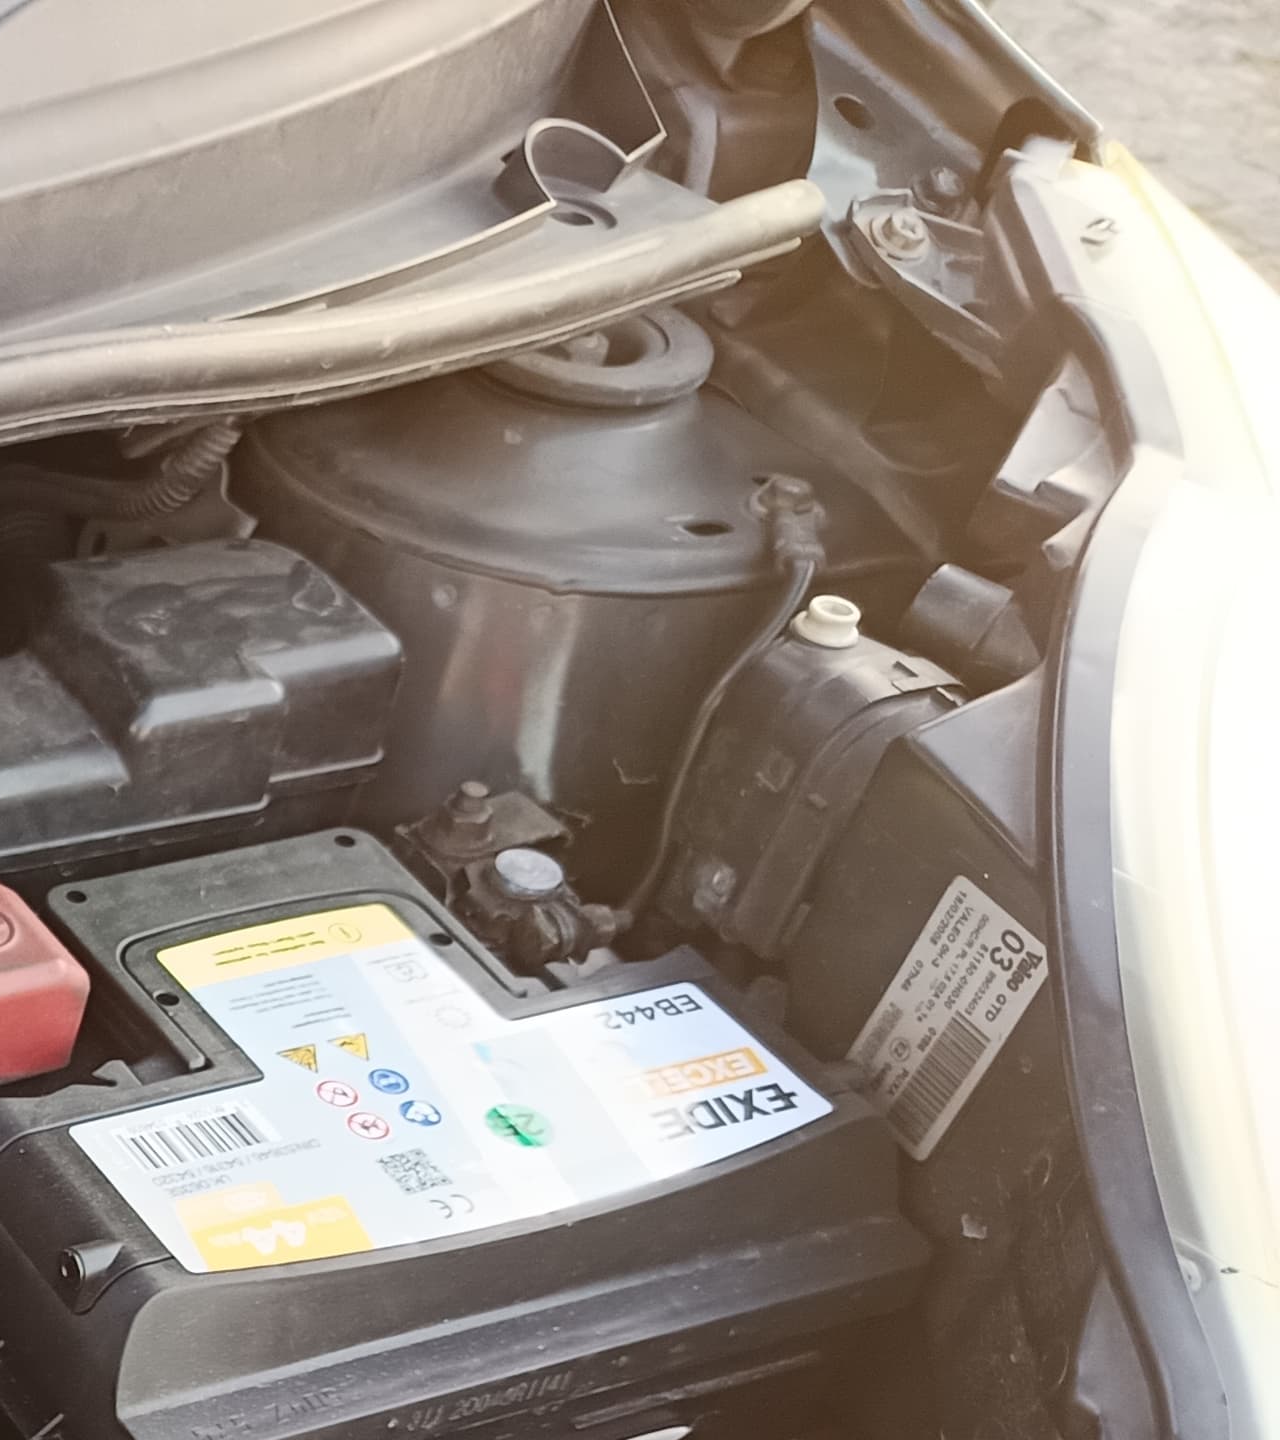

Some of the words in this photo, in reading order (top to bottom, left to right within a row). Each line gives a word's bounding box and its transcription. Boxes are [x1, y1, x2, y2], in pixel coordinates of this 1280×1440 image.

[990, 929, 1025, 972] 03
[1006, 951, 1044, 993] Valeo
[594, 994, 703, 1029] EB442
[649, 1083, 799, 1141] EXIDE
